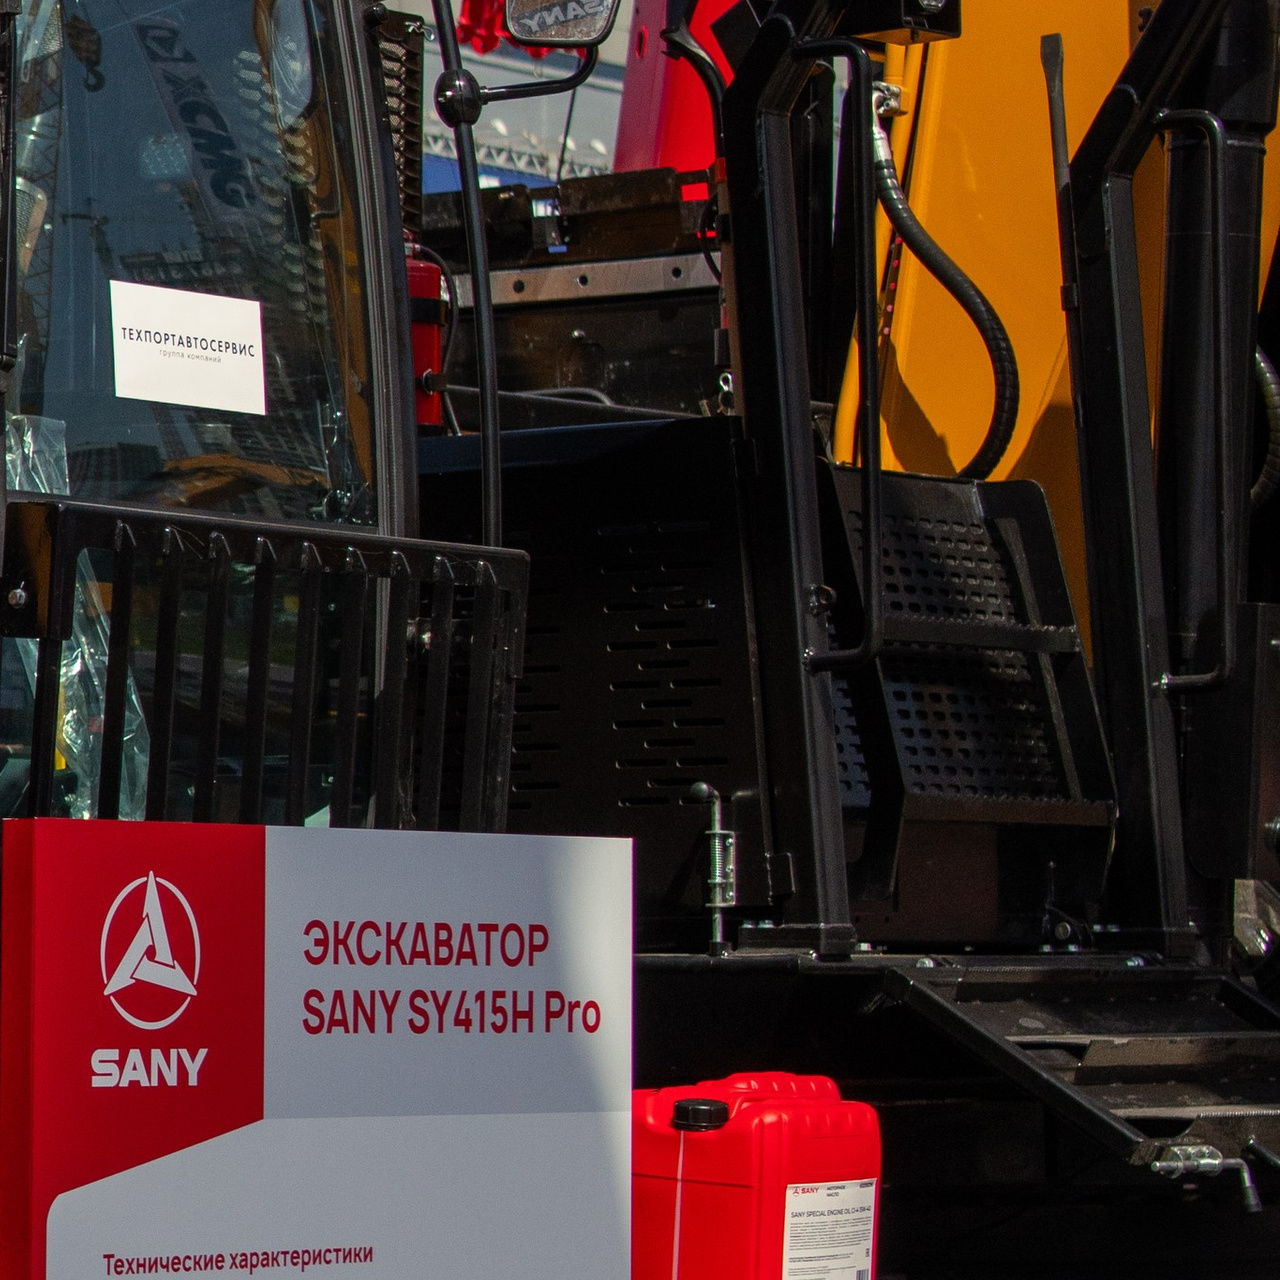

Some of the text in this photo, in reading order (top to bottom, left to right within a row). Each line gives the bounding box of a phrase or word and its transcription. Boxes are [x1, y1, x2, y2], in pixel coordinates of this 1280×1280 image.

[162, 70, 257, 210] XCMG
[121, 327, 255, 358] ТЕХПОРТАВТОСЕРВИС
[159, 349, 222, 364] группа компаний
[303, 919, 549, 968] ЭКСКАВАТОР
[302, 988, 601, 1035] SANY SY415H Pro
[90, 1047, 209, 1088] SANY
[102, 1246, 373, 1276] Технические характеристики
